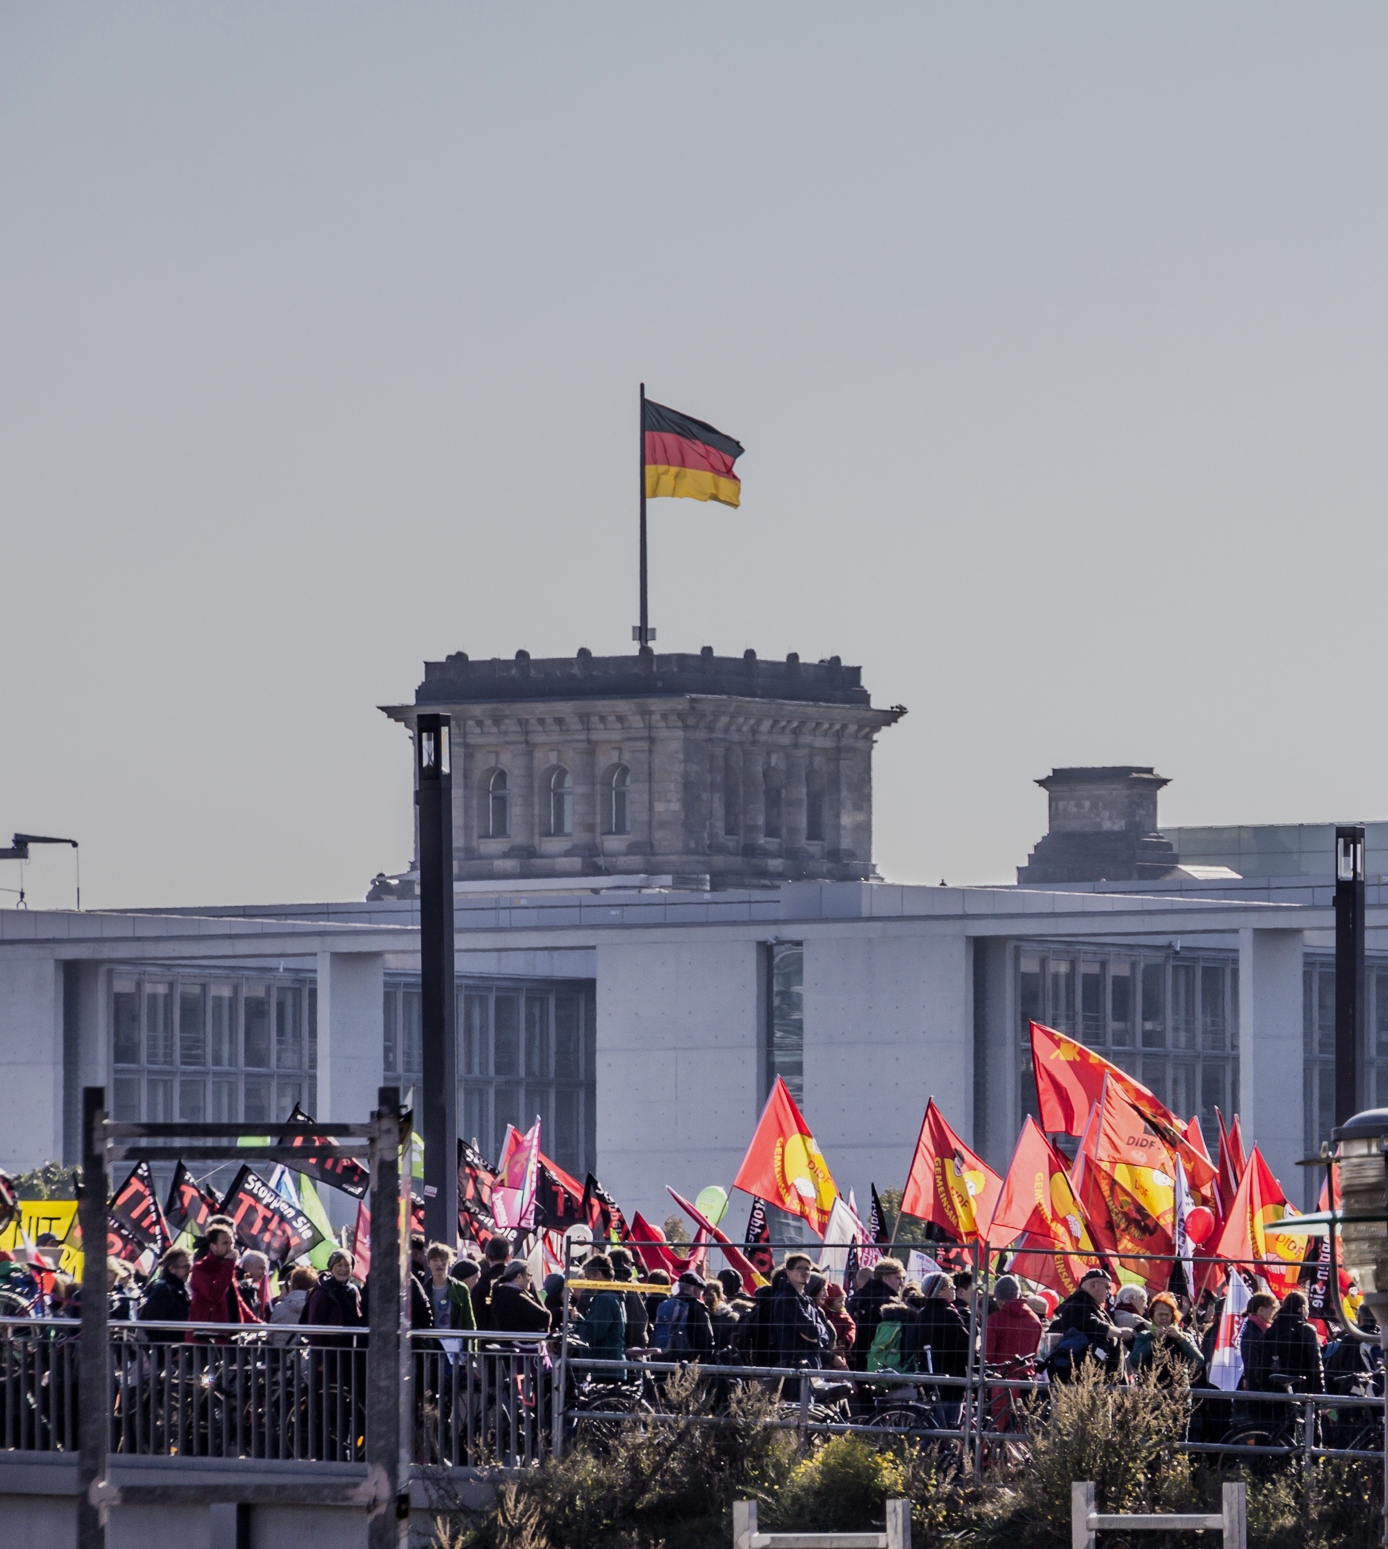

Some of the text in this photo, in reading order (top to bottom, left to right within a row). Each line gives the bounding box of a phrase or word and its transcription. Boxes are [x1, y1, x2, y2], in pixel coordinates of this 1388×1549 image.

[1126, 1135, 1156, 1150] DIDF
[773, 1137, 792, 1206] GEMEINSAM
[810, 1209, 829, 1224] WIR
[806, 1160, 833, 1184] DIDF
[934, 1157, 960, 1228] GEMEINSAM
[244, 1174, 296, 1218] Stoppen
[292, 1216, 313, 1239] Sie
[1275, 1234, 1305, 1256] DIDF
